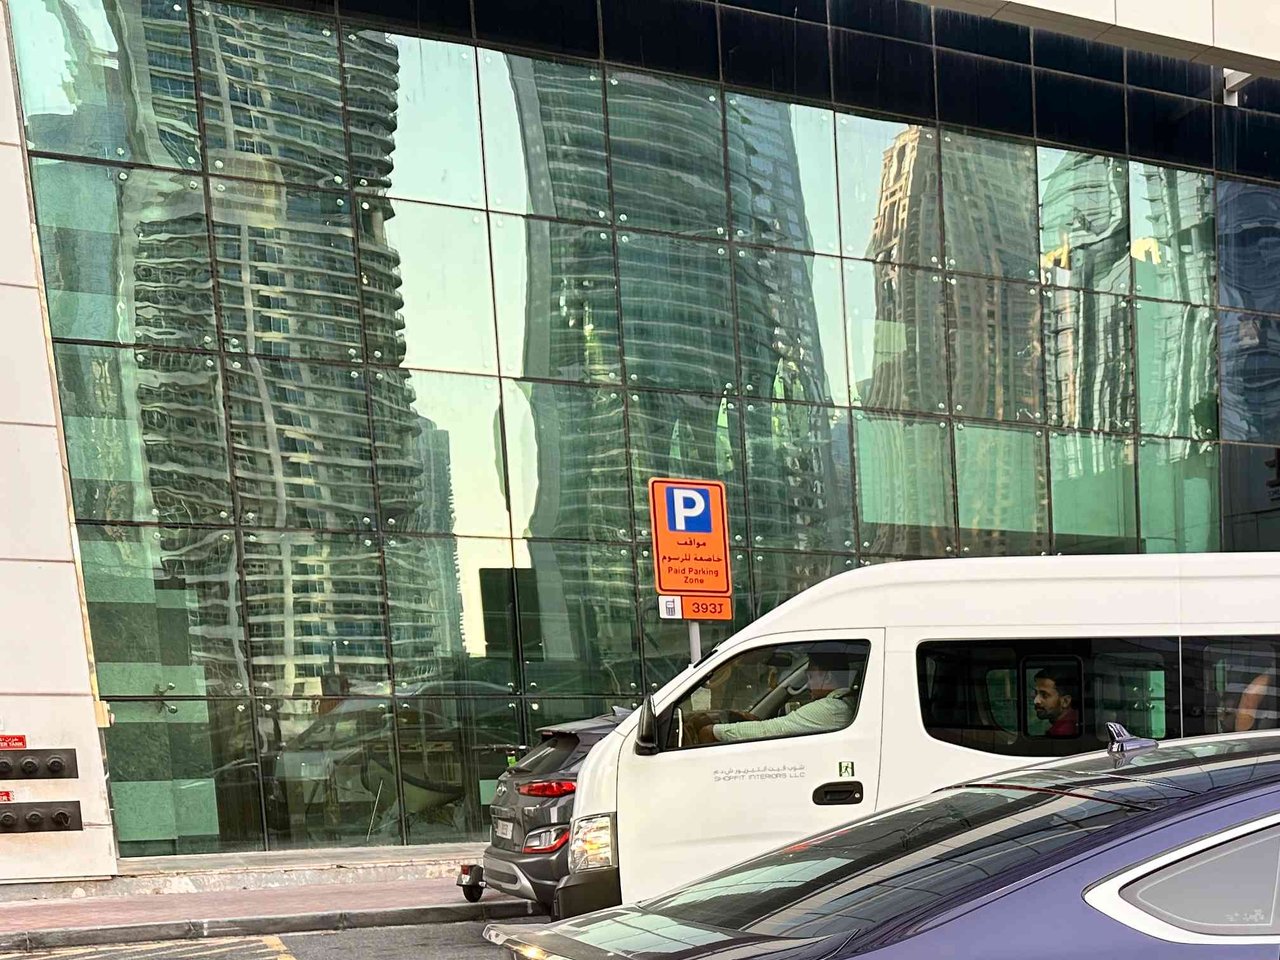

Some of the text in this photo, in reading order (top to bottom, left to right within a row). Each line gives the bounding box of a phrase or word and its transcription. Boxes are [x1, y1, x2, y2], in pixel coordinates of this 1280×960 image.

[673, 488, 705, 531] P
[676, 537, 706, 548] مواقف
[661, 553, 722, 563] خاضعة للرسوم
[667, 566, 719, 577] Paid Parking
[684, 576, 704, 584] Zone
[691, 602, 724, 614] 393J
